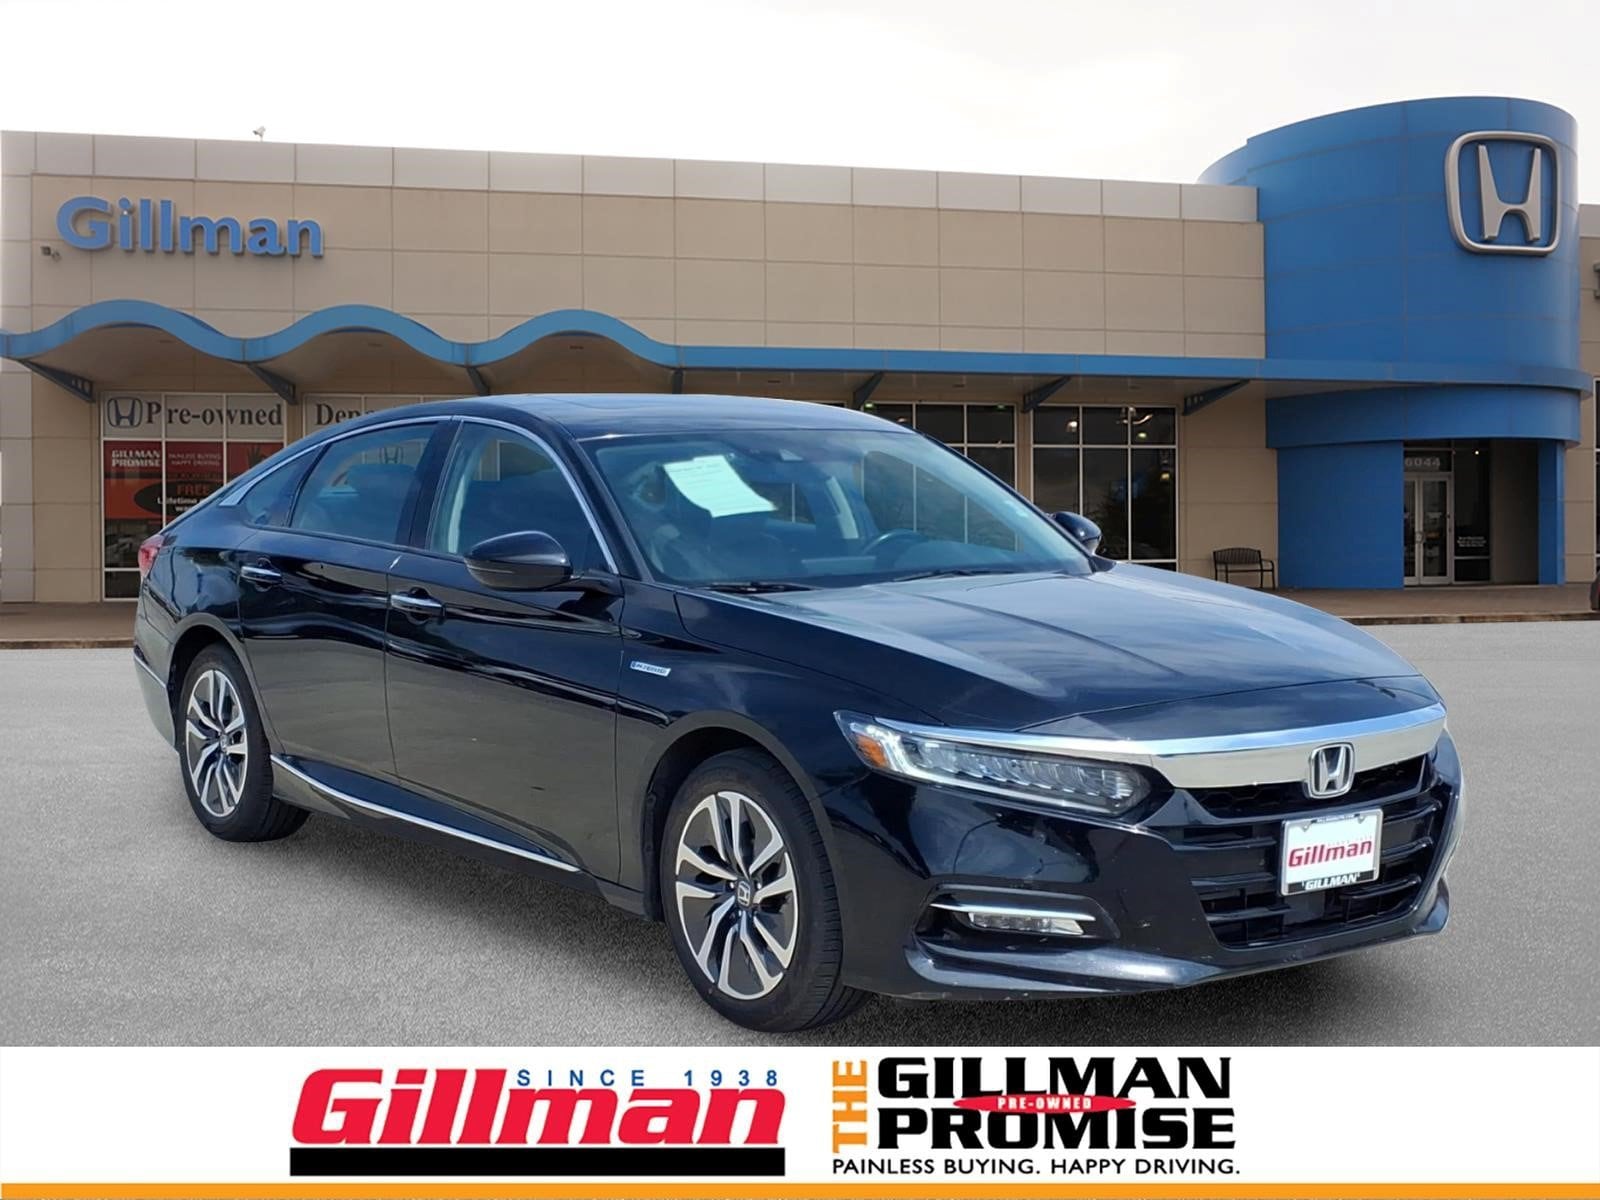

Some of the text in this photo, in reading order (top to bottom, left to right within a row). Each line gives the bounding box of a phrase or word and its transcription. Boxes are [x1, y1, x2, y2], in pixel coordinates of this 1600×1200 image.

[56, 196, 323, 257] Gillman
[146, 401, 283, 426] Pre-owned
[111, 450, 160, 458] GILLMAN
[111, 459, 160, 467] PROMISE
[1288, 840, 1373, 868] Gillman
